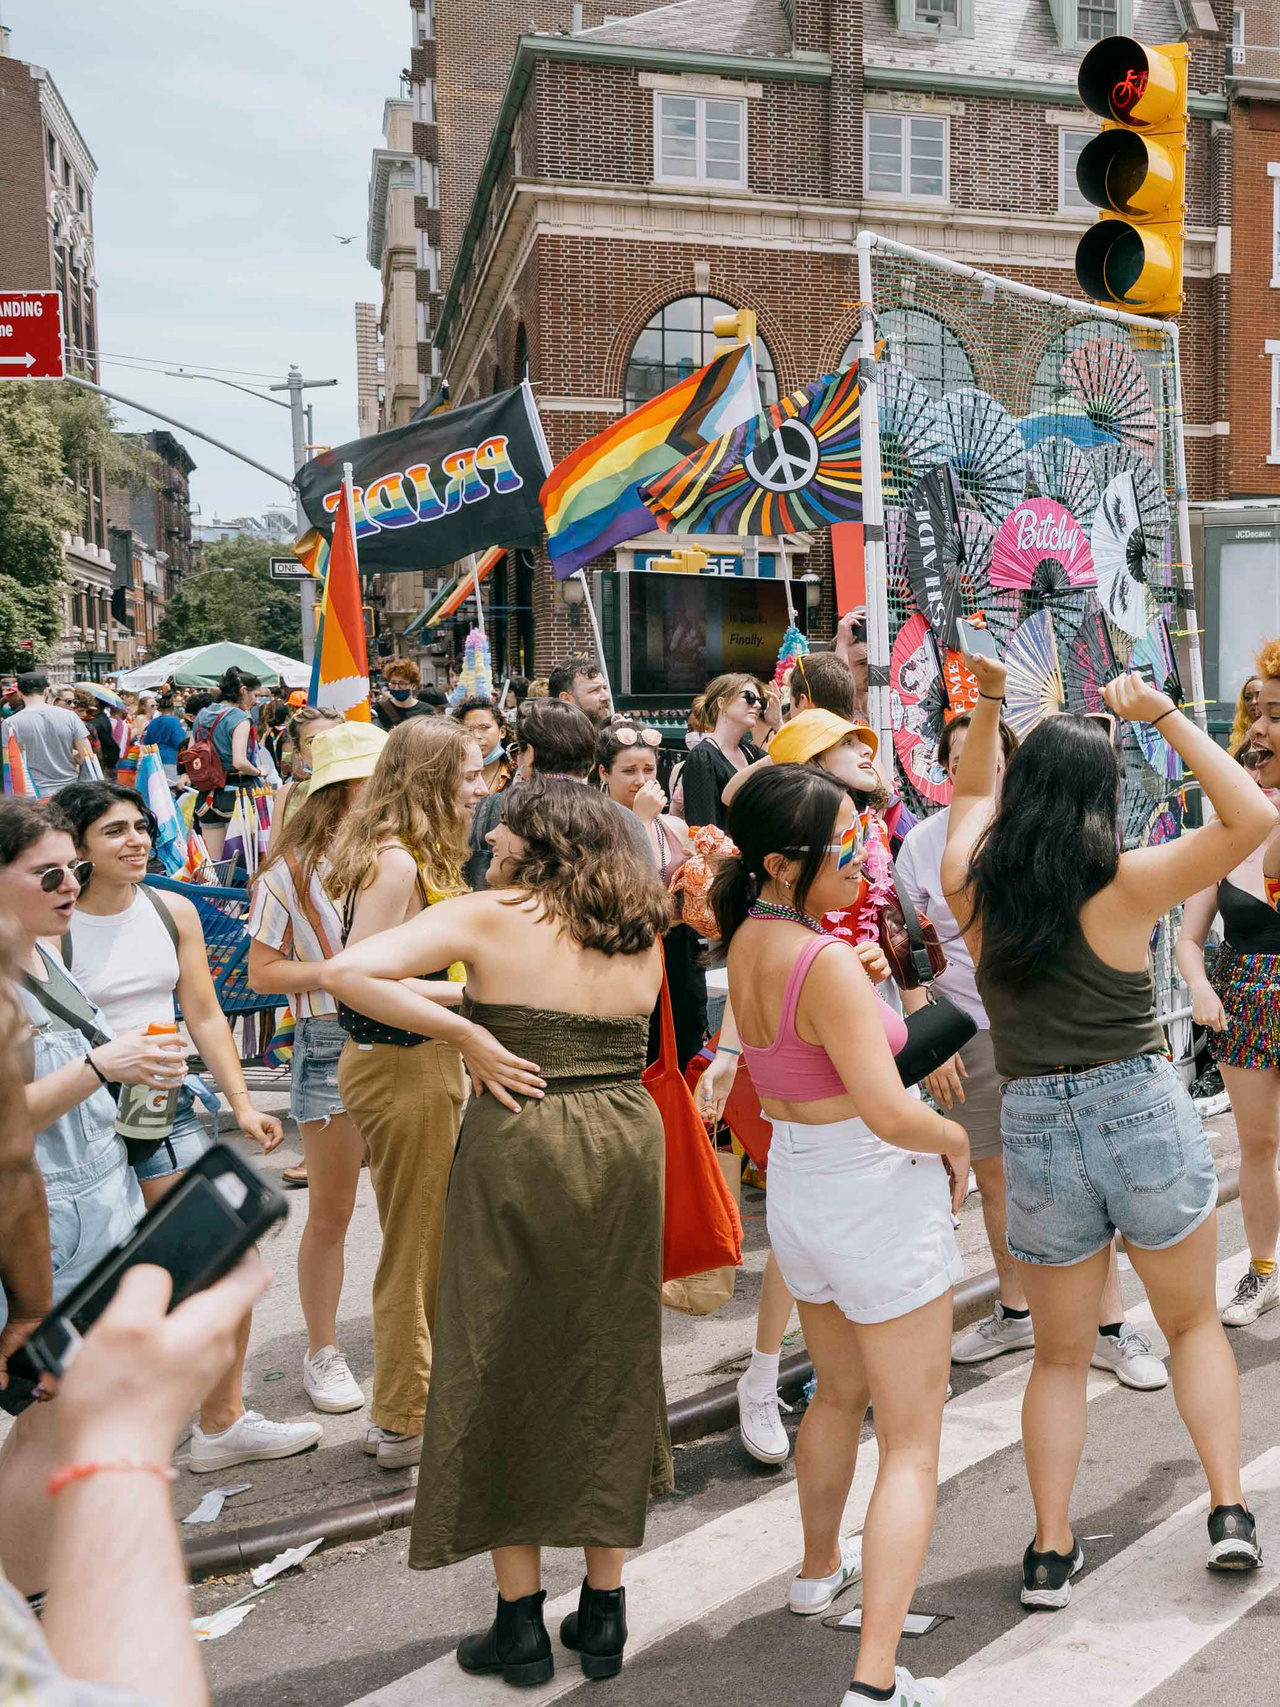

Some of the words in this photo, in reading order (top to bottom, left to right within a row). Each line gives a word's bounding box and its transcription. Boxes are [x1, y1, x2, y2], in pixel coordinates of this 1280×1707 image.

[1013, 508, 1081, 563] Bitchy
[1235, 530, 1272, 539] JCDecaux
[277, 564, 298, 573] ONE
[730, 633, 765, 648] Finally.
[947, 660, 963, 695] ME
